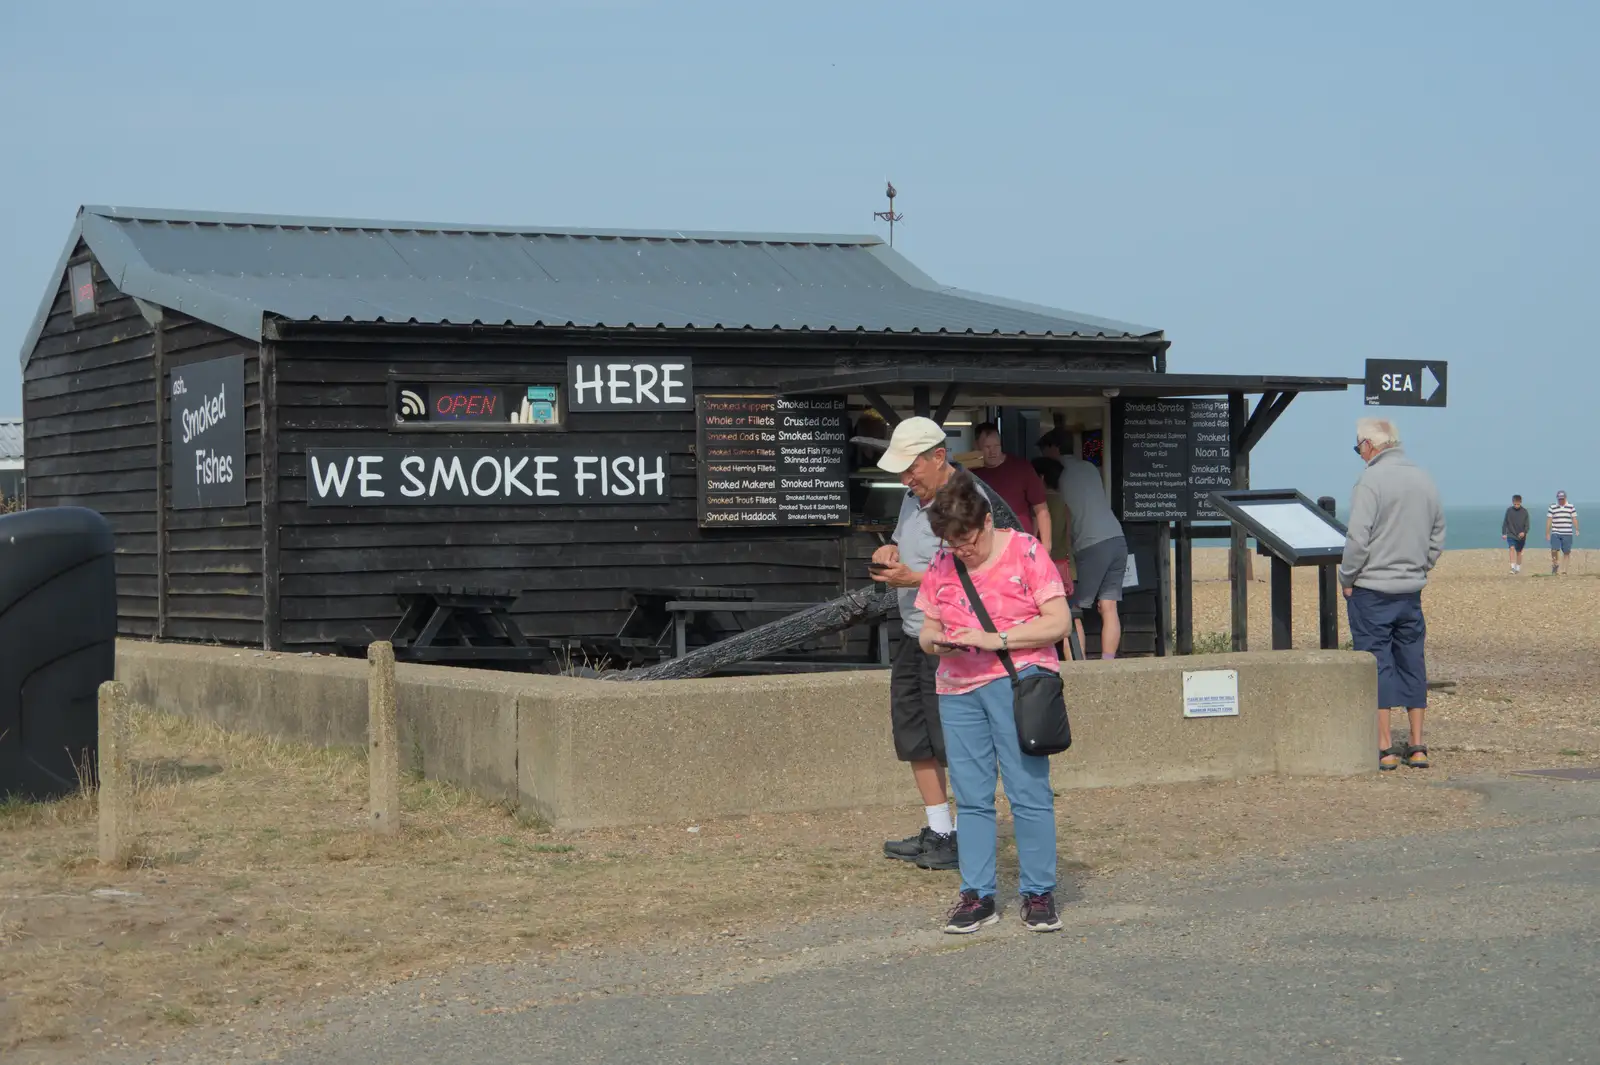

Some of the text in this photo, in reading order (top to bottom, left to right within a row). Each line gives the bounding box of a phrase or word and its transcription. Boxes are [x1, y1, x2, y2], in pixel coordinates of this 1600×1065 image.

[574, 364, 687, 404] HERE
[1381, 373, 1413, 392] SEA
[436, 395, 497, 415] OPEN
[707, 401, 740, 411] Smoked
[777, 400, 845, 409] Smoked Local Eel
[1125, 403, 1185, 413] Smoked Sprats
[182, 382, 226, 443] Smoked
[1190, 411, 1218, 419] Selection
[706, 416, 733, 425] Whole
[748, 416, 775, 425] Fillets
[783, 417, 840, 426] Crusted Cold
[708, 432, 776, 441] Smoked Cod's Roe
[778, 431, 845, 441] Smoked Salmon
[1197, 433, 1226, 442] Smoked
[708, 448, 731, 456] Smoked
[756, 448, 775, 456] Fillets
[781, 447, 844, 455] Smoked Fish Pie Mix
[784, 456, 841, 464] Skinned and Diced
[195, 448, 233, 485] Fishes
[732, 465, 756, 473] Herring
[1191, 465, 1219, 473] Smoked
[311, 456, 666, 497] WE SMOKE FISH
[1194, 476, 1216, 484] Garlic
[707, 480, 776, 489] Smoked Makerel
[781, 479, 845, 488] Smoked Prawns
[708, 496, 777, 504] Smoked Trout Fillets
[706, 512, 777, 521] Smoked Haddock
[1165, 511, 1187, 519] Shrimps
